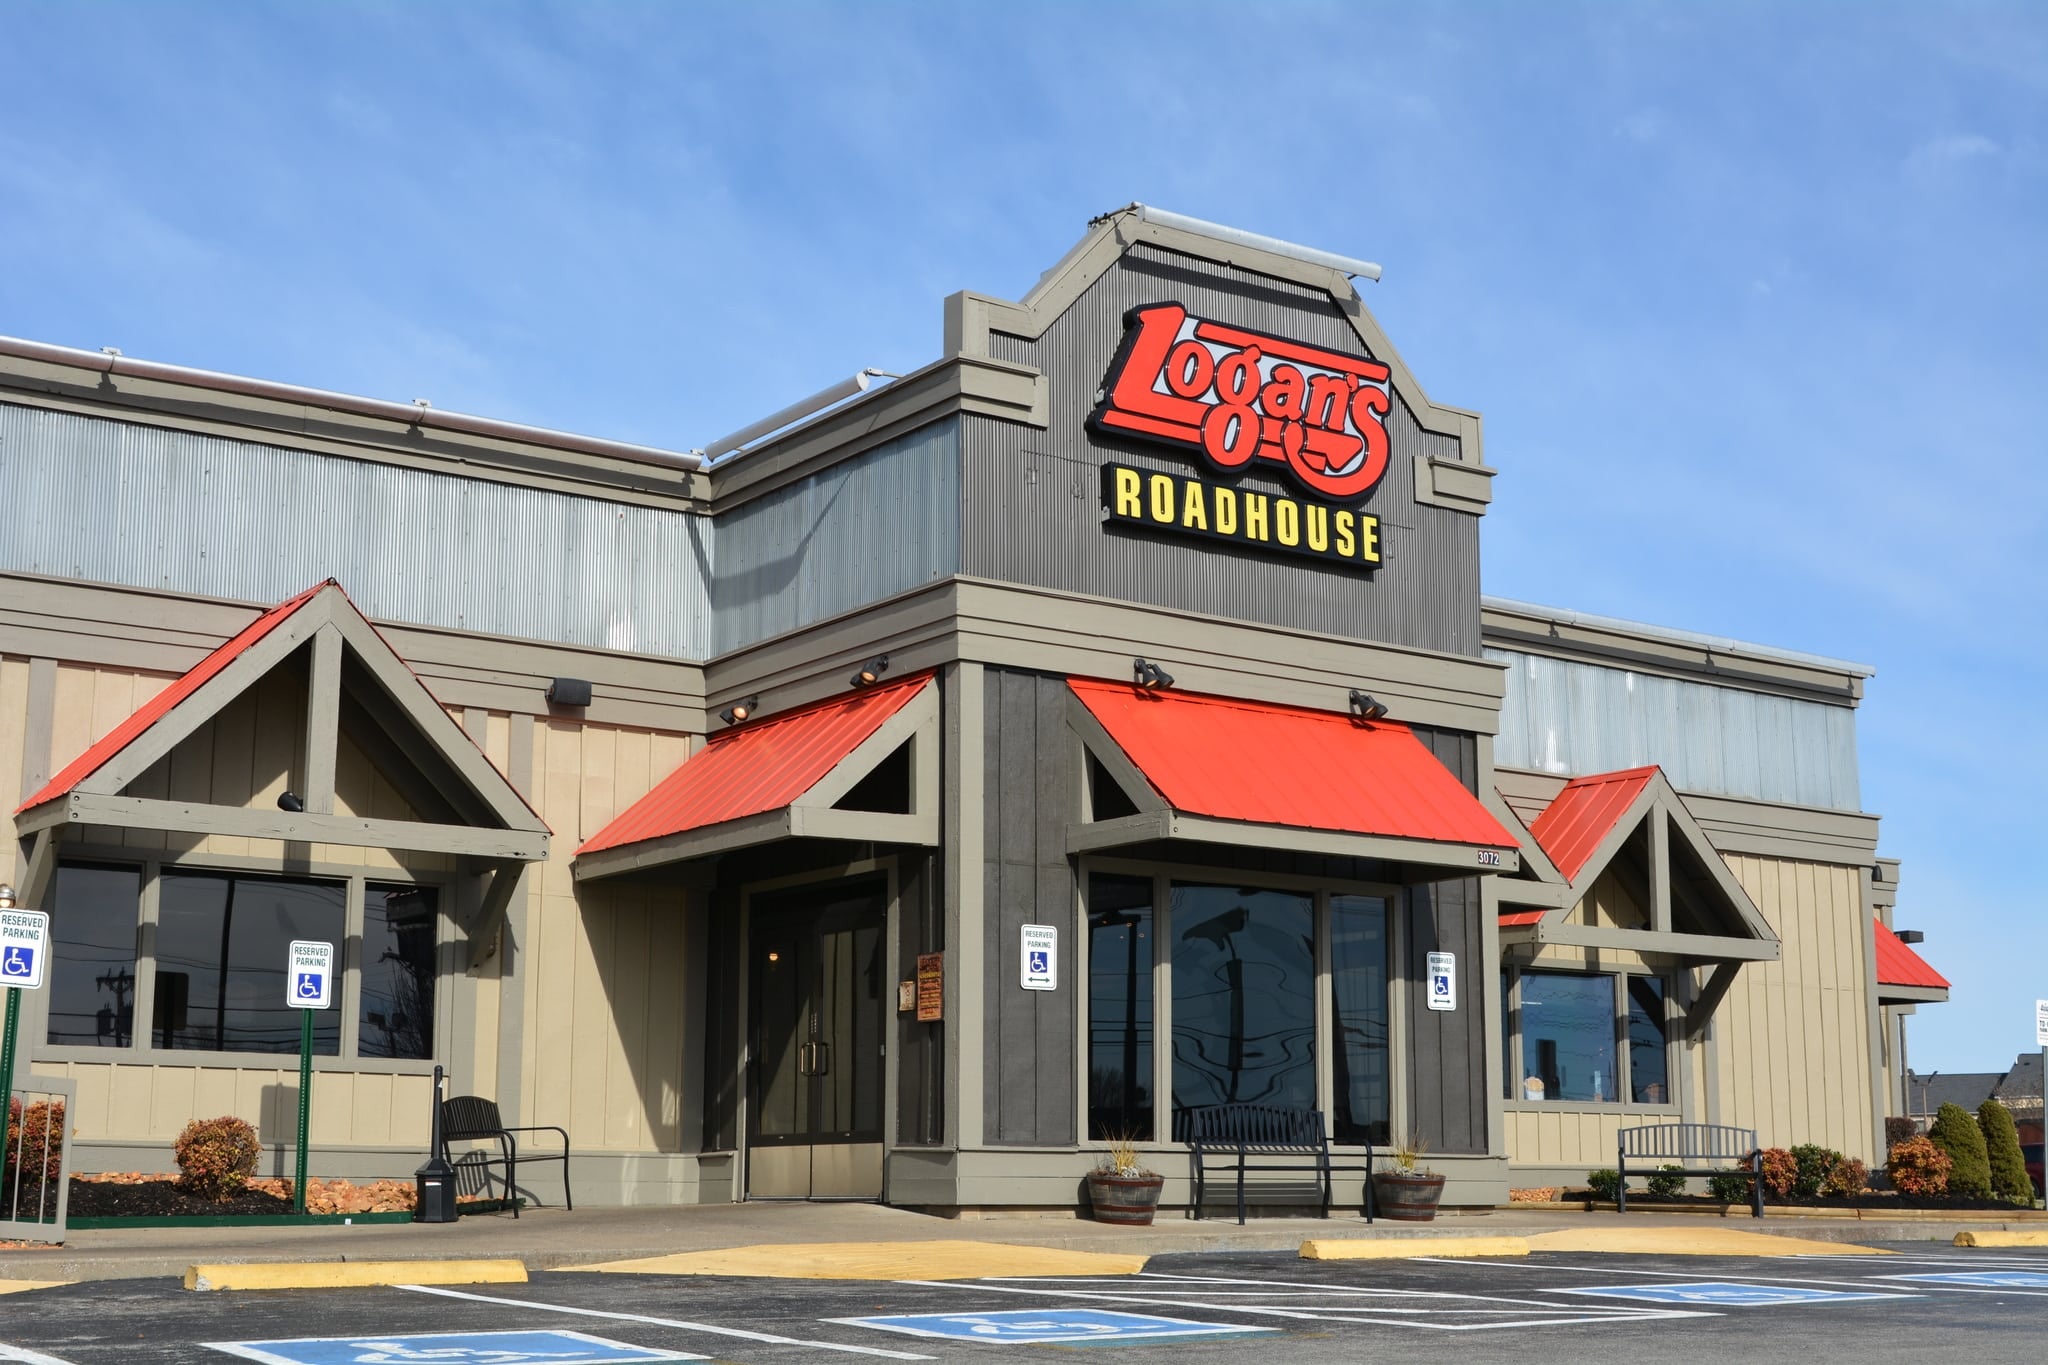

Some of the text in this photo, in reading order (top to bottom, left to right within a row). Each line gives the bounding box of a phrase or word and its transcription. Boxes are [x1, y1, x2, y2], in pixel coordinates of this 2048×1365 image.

[1102, 304, 1391, 497] Logan's
[1115, 467, 1381, 563] ROADHOUSE
[1478, 851, 1499, 865] 3072
[1, 914, 43, 928] RESERVED
[3, 928, 40, 940] PARKING
[1025, 930, 1054, 939] RESERVED
[1027, 940, 1052, 949] PARKING
[295, 946, 329, 956] RESERVED
[296, 956, 326, 967] PARKING
